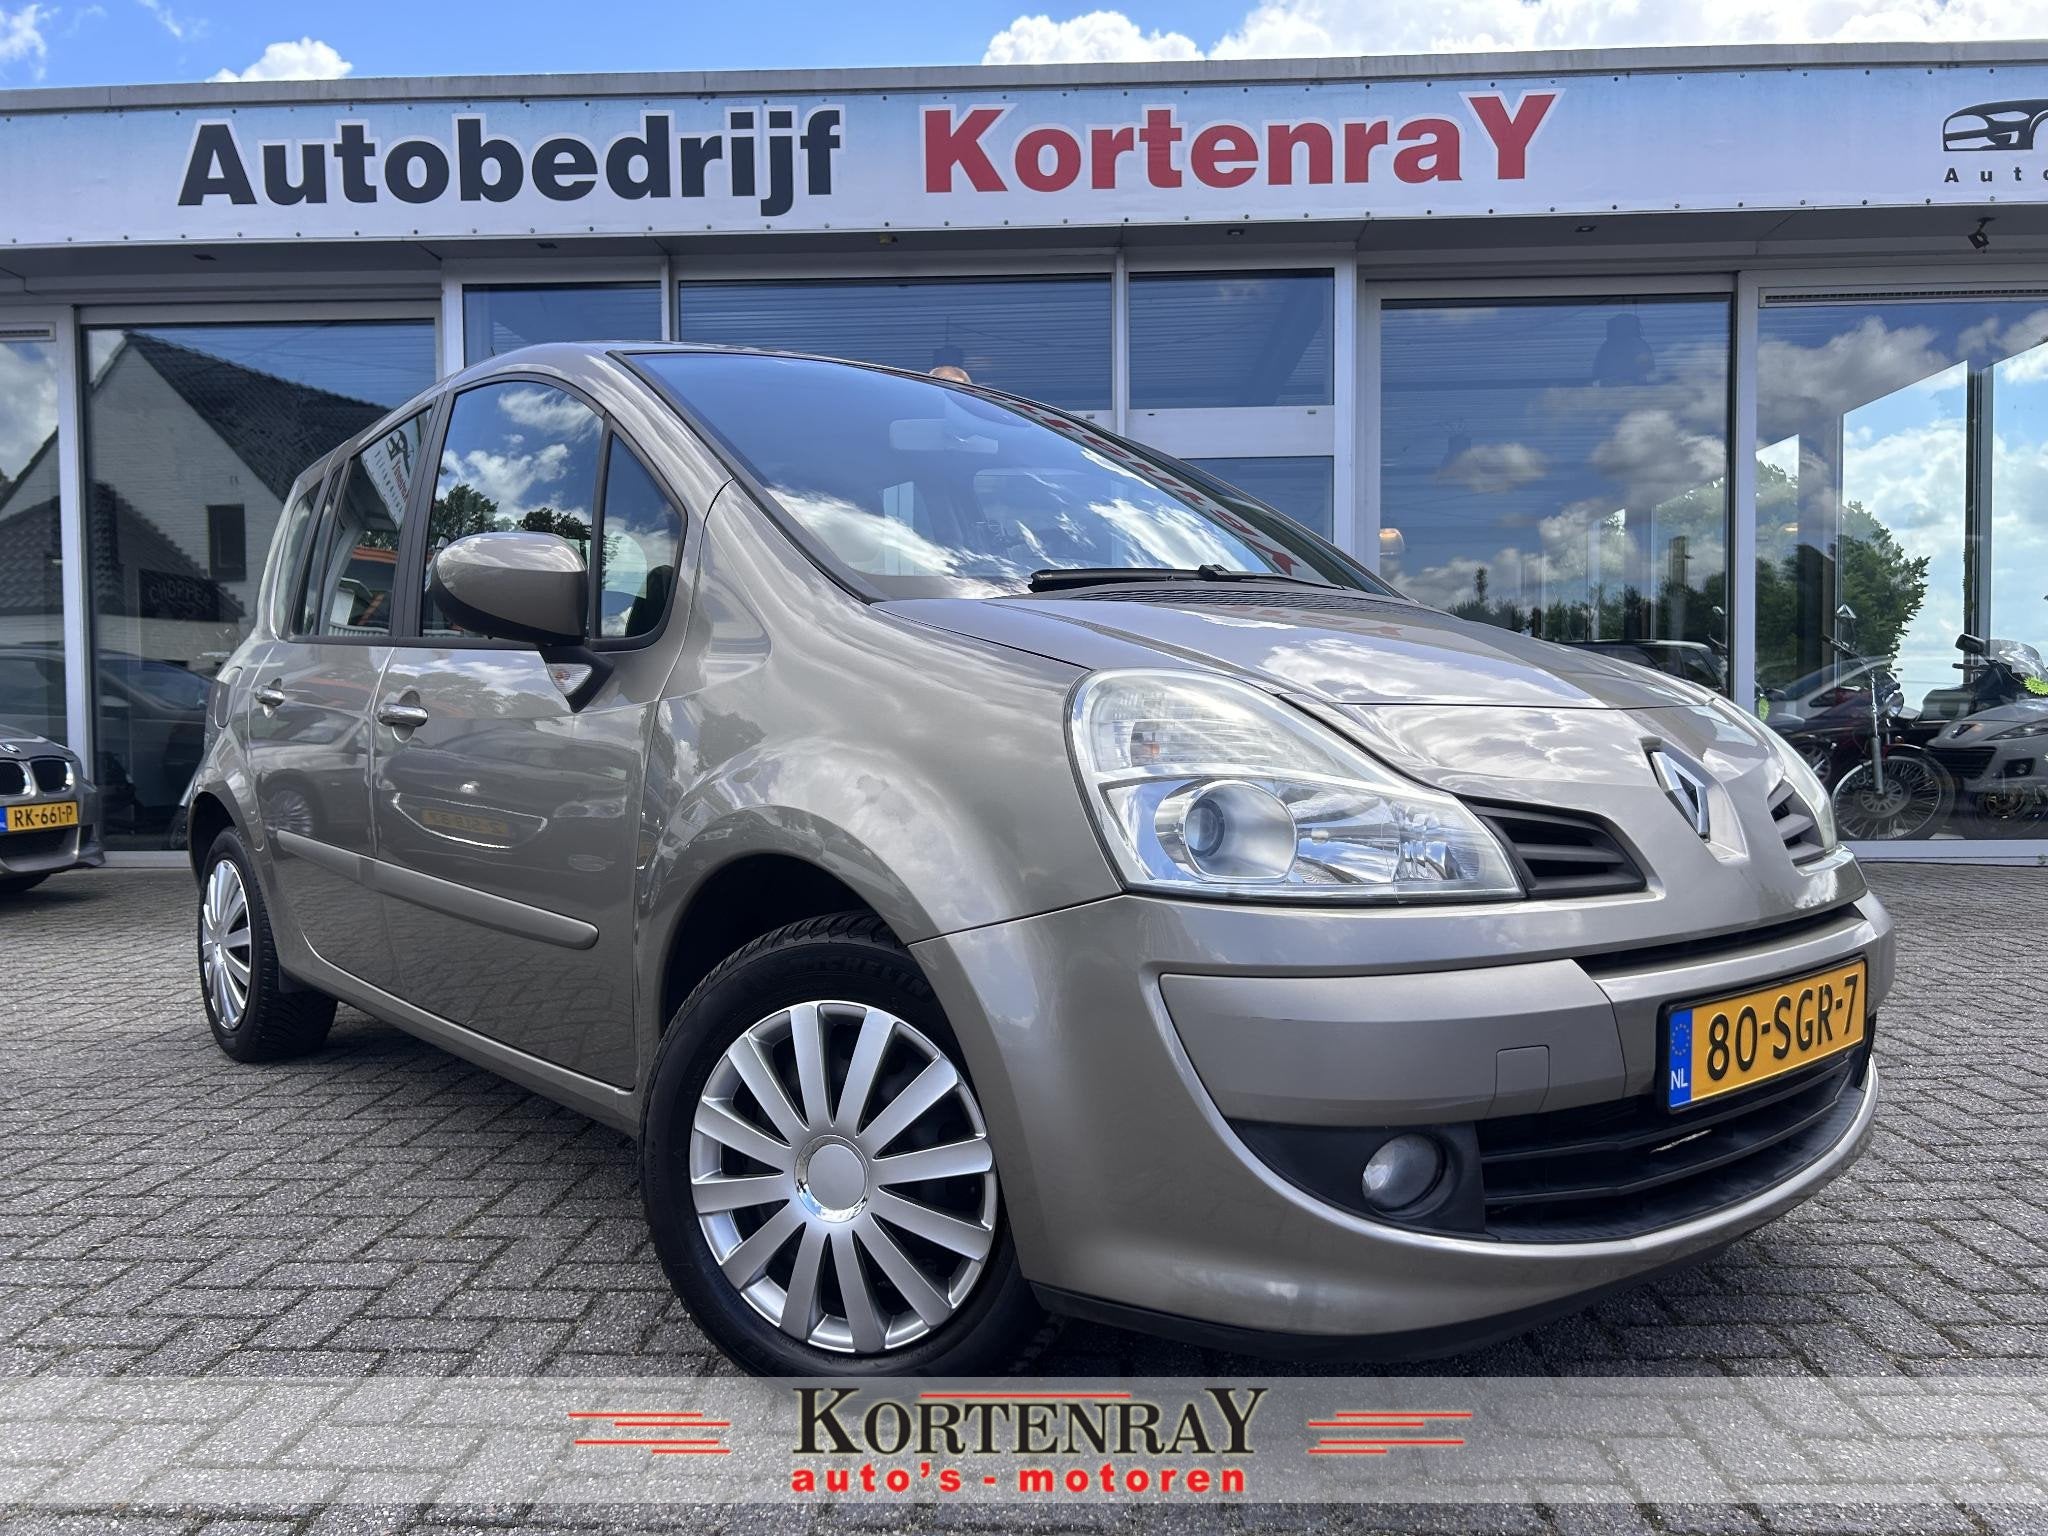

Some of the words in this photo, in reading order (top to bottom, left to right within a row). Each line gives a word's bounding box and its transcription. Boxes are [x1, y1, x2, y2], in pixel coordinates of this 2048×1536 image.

[178, 109, 841, 217] Autobedrijf
[924, 93, 1557, 194] KortenraY
[14, 805, 73, 828] RK-661-P
[1706, 971, 1859, 1081] 80-SGR-7
[1670, 1067, 1689, 1091] NL
